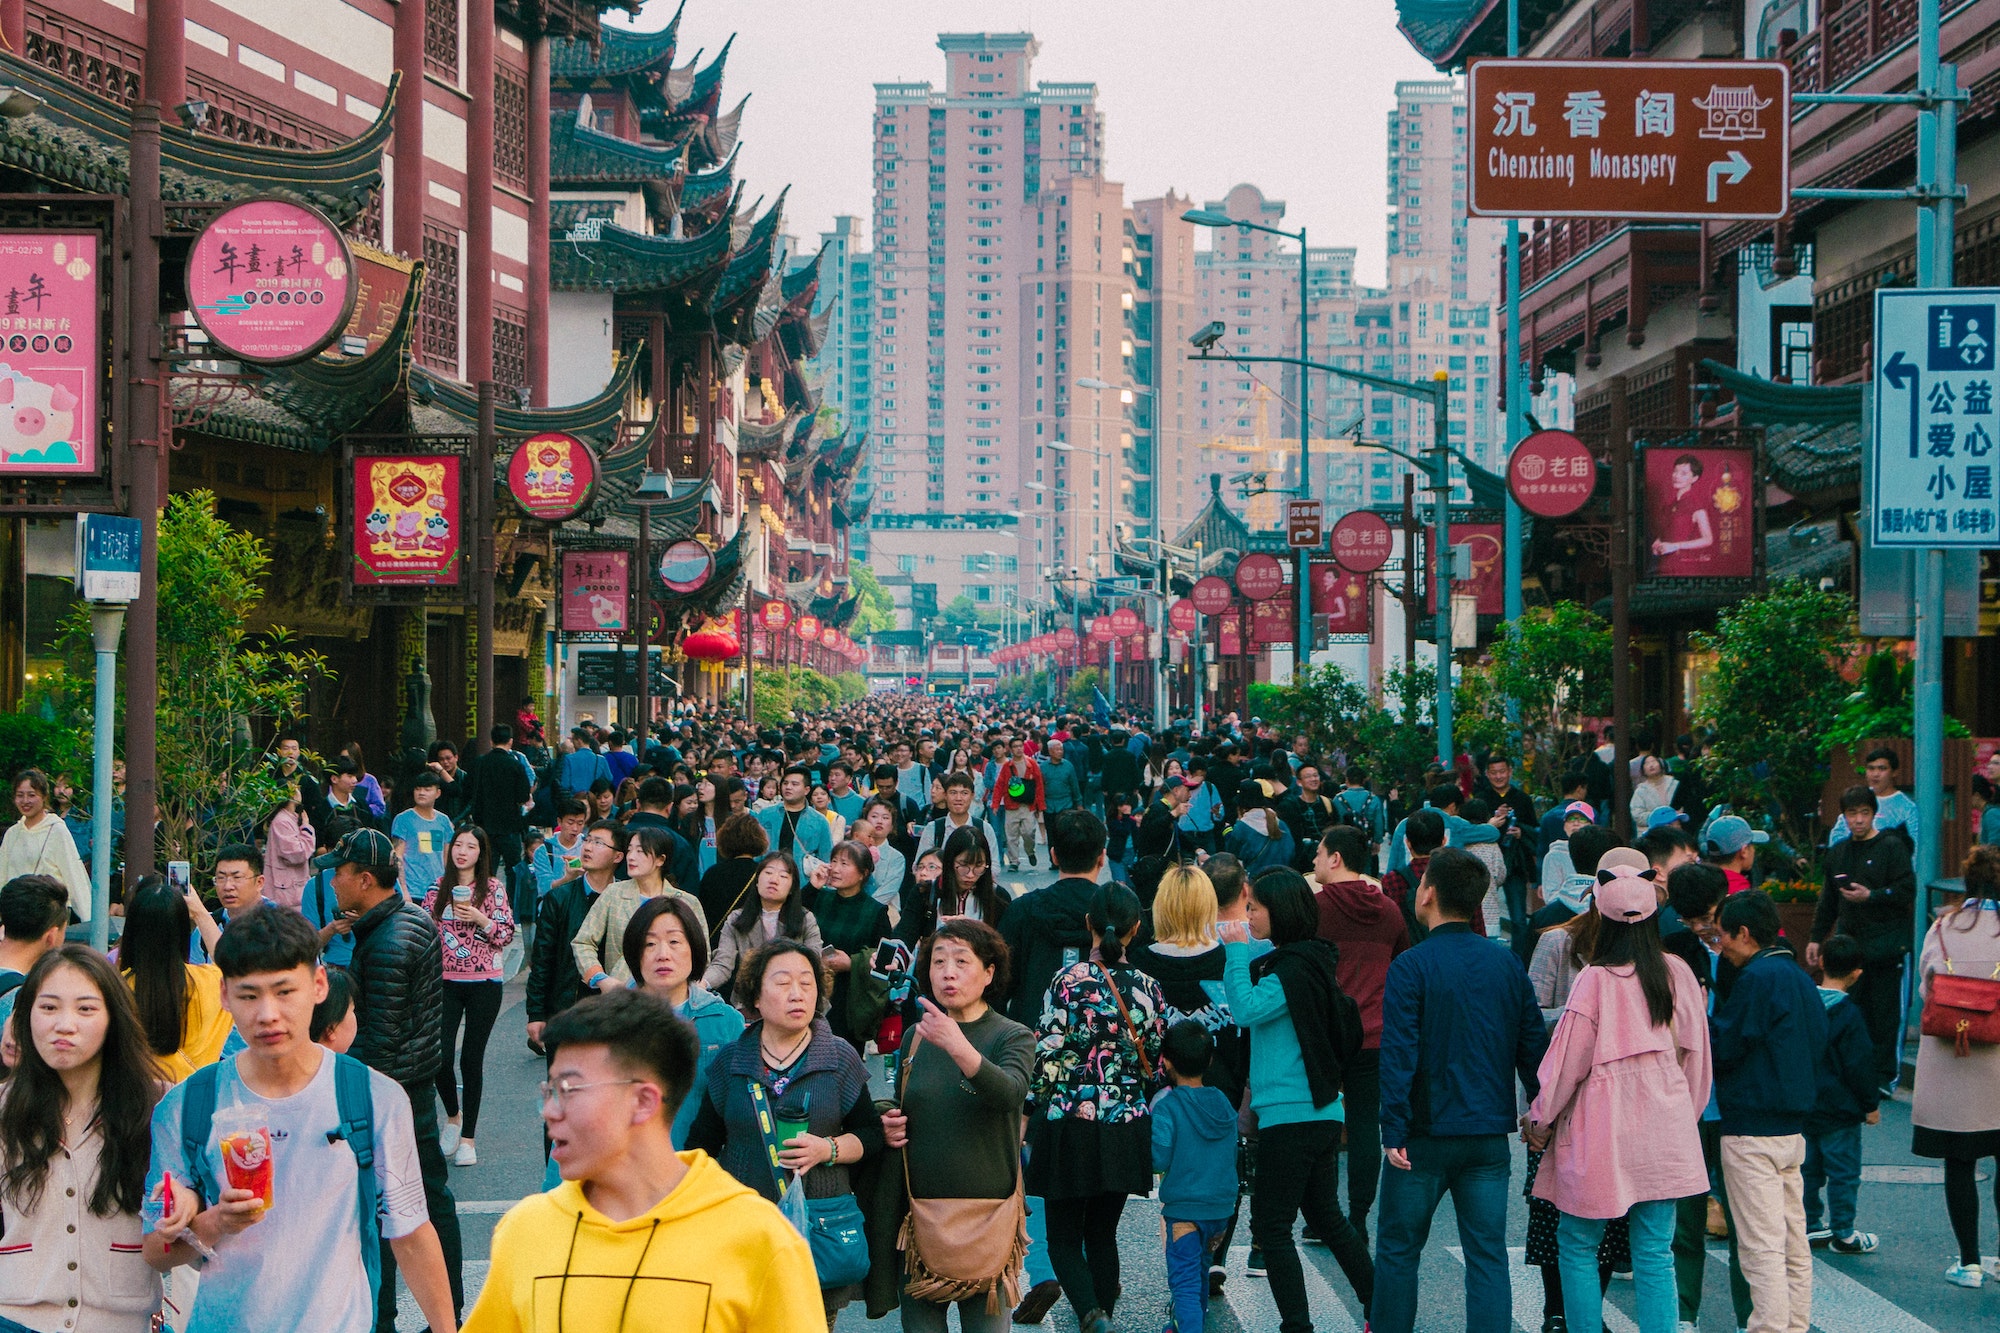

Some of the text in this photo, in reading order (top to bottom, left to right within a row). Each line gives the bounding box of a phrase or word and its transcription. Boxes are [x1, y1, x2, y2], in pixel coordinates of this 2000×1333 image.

[1493, 89, 1675, 138] 沉香阁
[1488, 146, 1677, 188] Chenxiang Monaspery
[255, 278, 278, 288] 2019
[1927, 379, 1992, 415] 公益
[1927, 422, 1993, 458] 爱心
[1549, 455, 1589, 478] 老庙
[1926, 464, 1993, 500] 小屋
[1360, 529, 1387, 545] 老庙
[1258, 566, 1279, 579] 老庙
